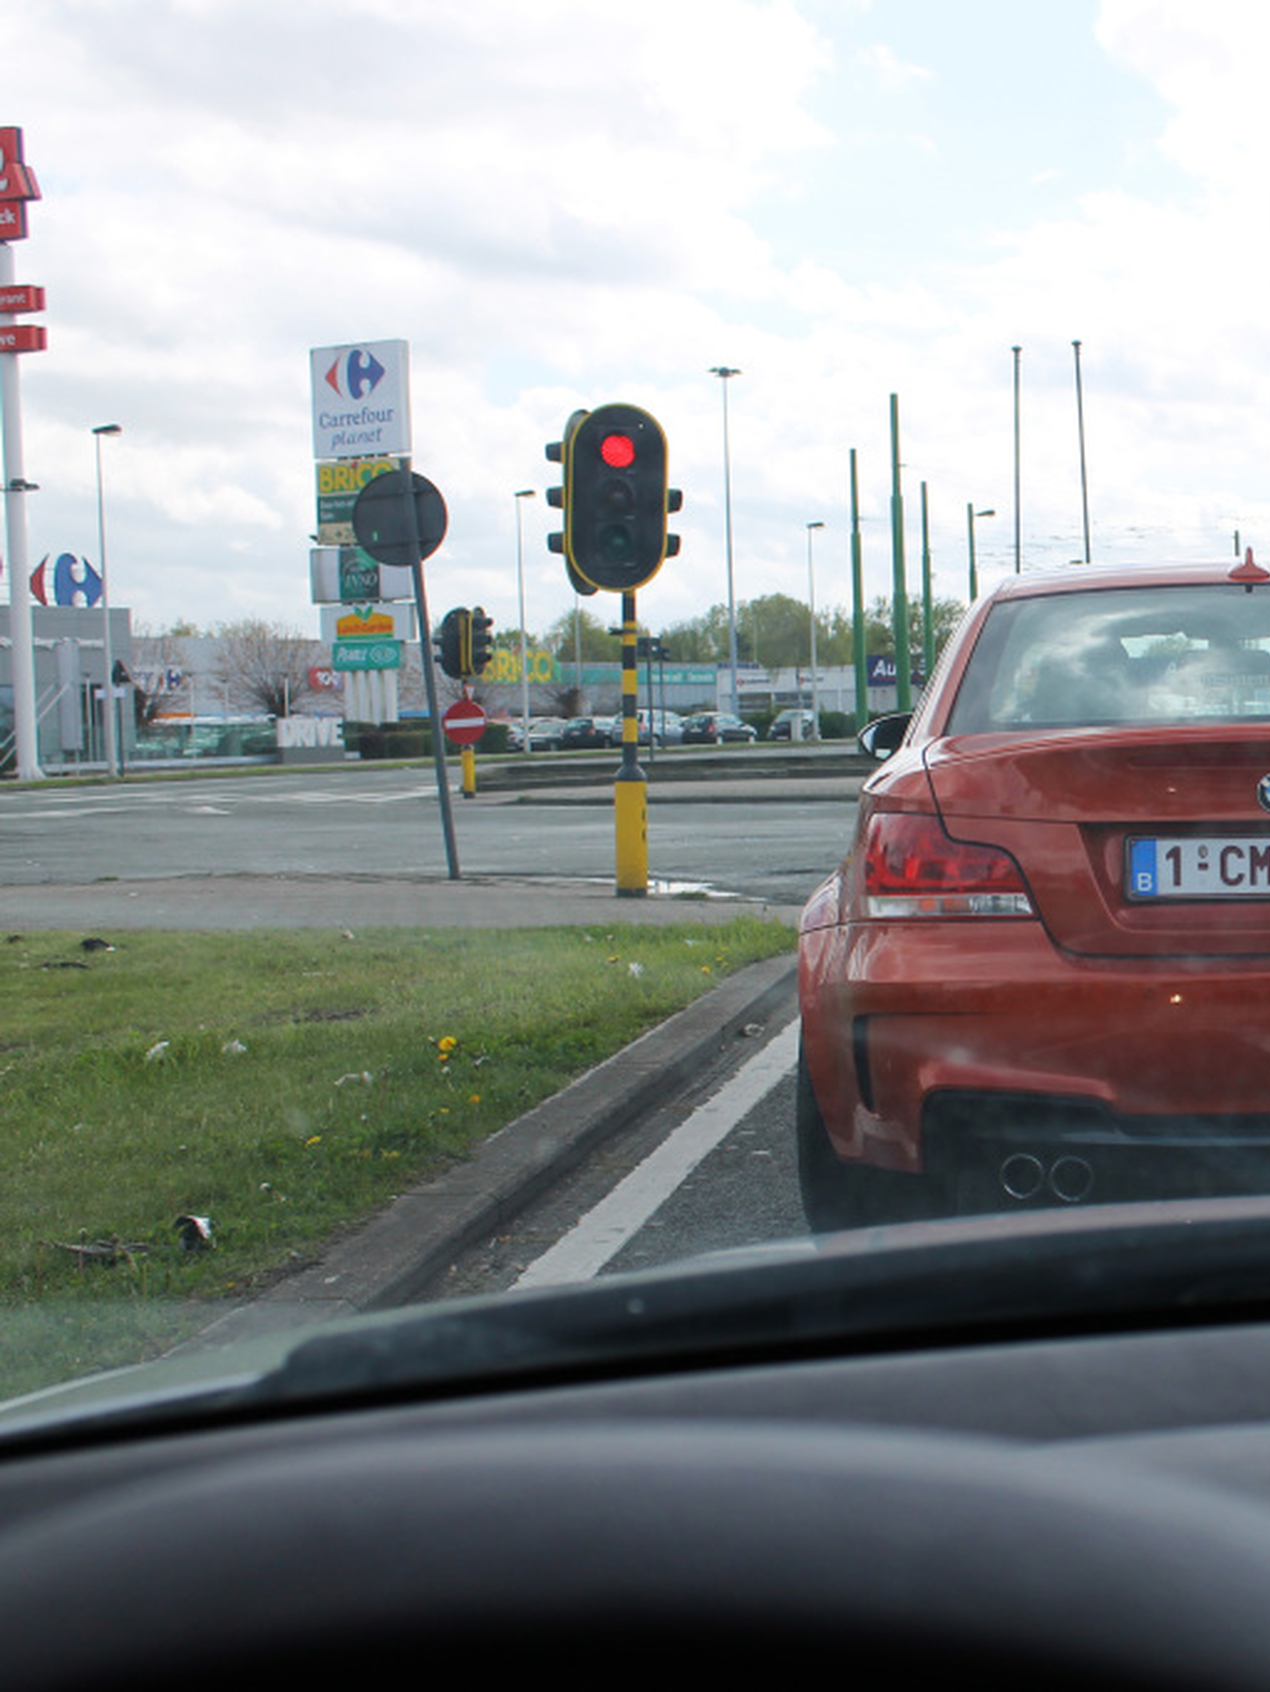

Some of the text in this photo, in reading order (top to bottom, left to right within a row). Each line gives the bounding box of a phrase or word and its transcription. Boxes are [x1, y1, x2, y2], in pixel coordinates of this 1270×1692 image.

[318, 406, 394, 429] Carrefour
[330, 428, 382, 451] planet
[277, 717, 346, 748] DRIVE
[1136, 872, 1152, 892] B
